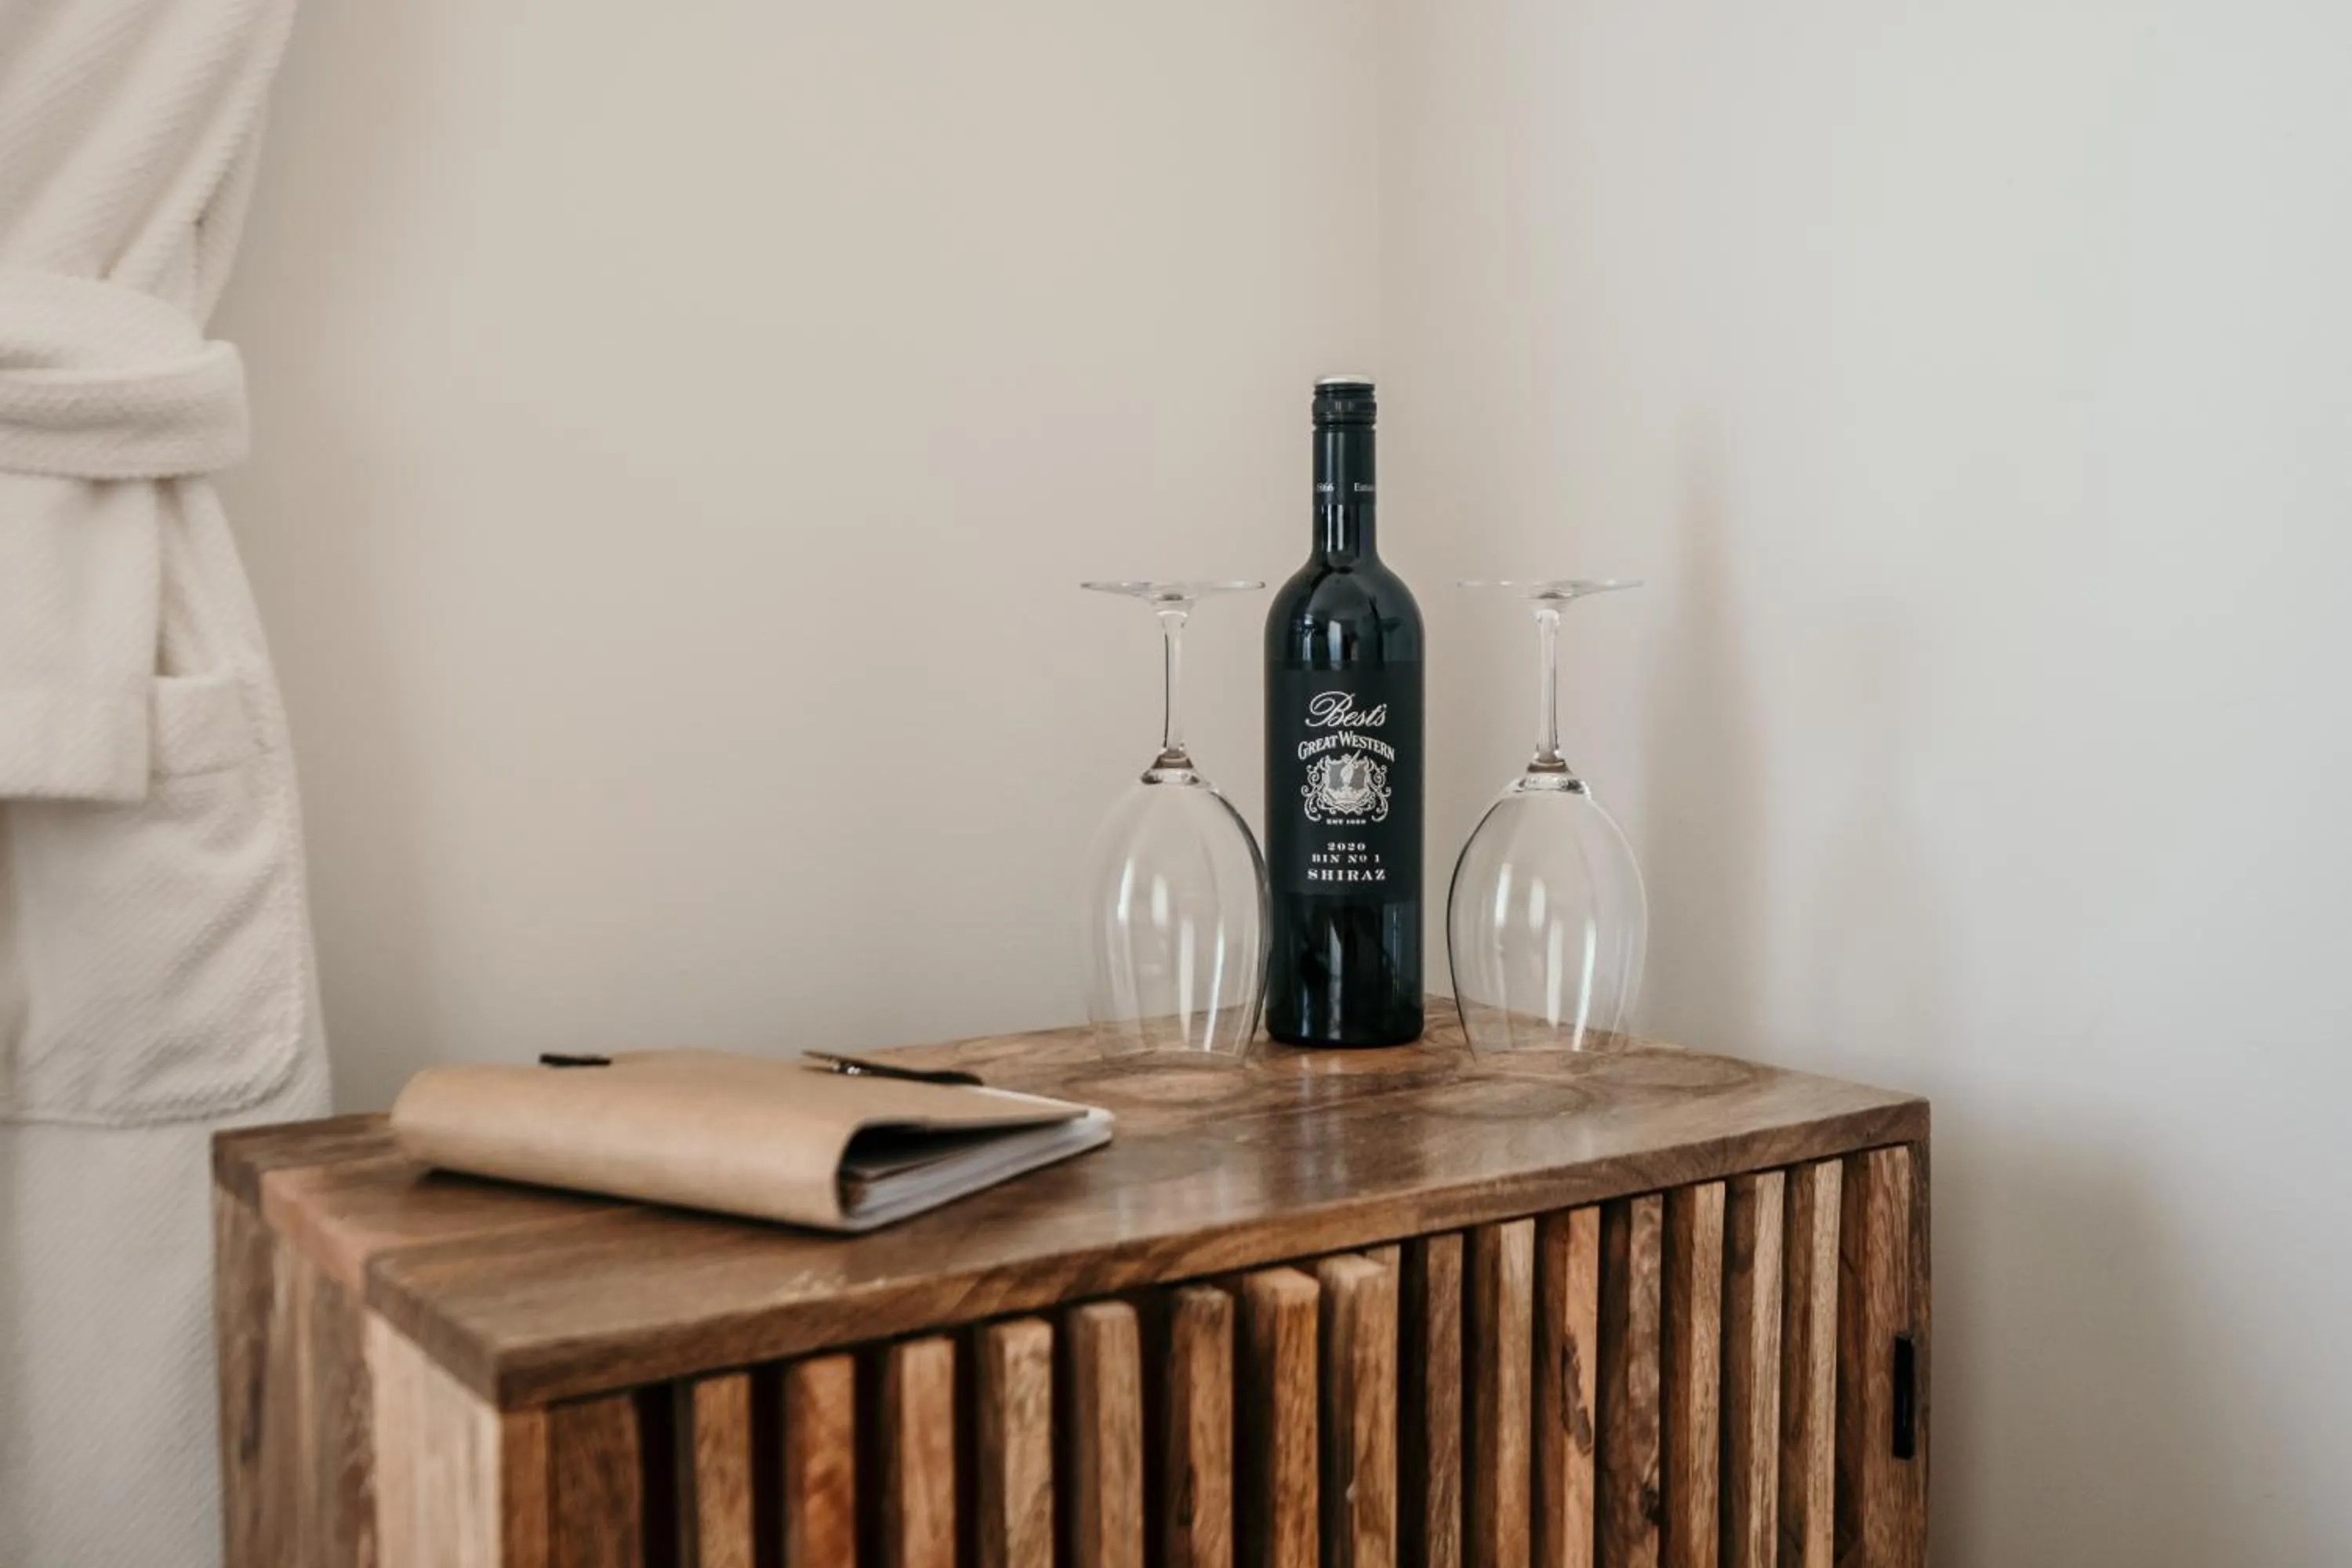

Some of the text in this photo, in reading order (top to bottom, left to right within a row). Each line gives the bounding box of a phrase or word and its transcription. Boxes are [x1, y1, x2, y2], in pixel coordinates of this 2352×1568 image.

[1305, 691, 1388, 728] Best's
[1298, 730, 1396, 763] GREAT WESTERN
[1327, 842, 1367, 851] 2020
[1312, 853, 1341, 863] BIN
[1374, 854, 1380, 863] 1
[1307, 869, 1386, 881] SHIRAZ
